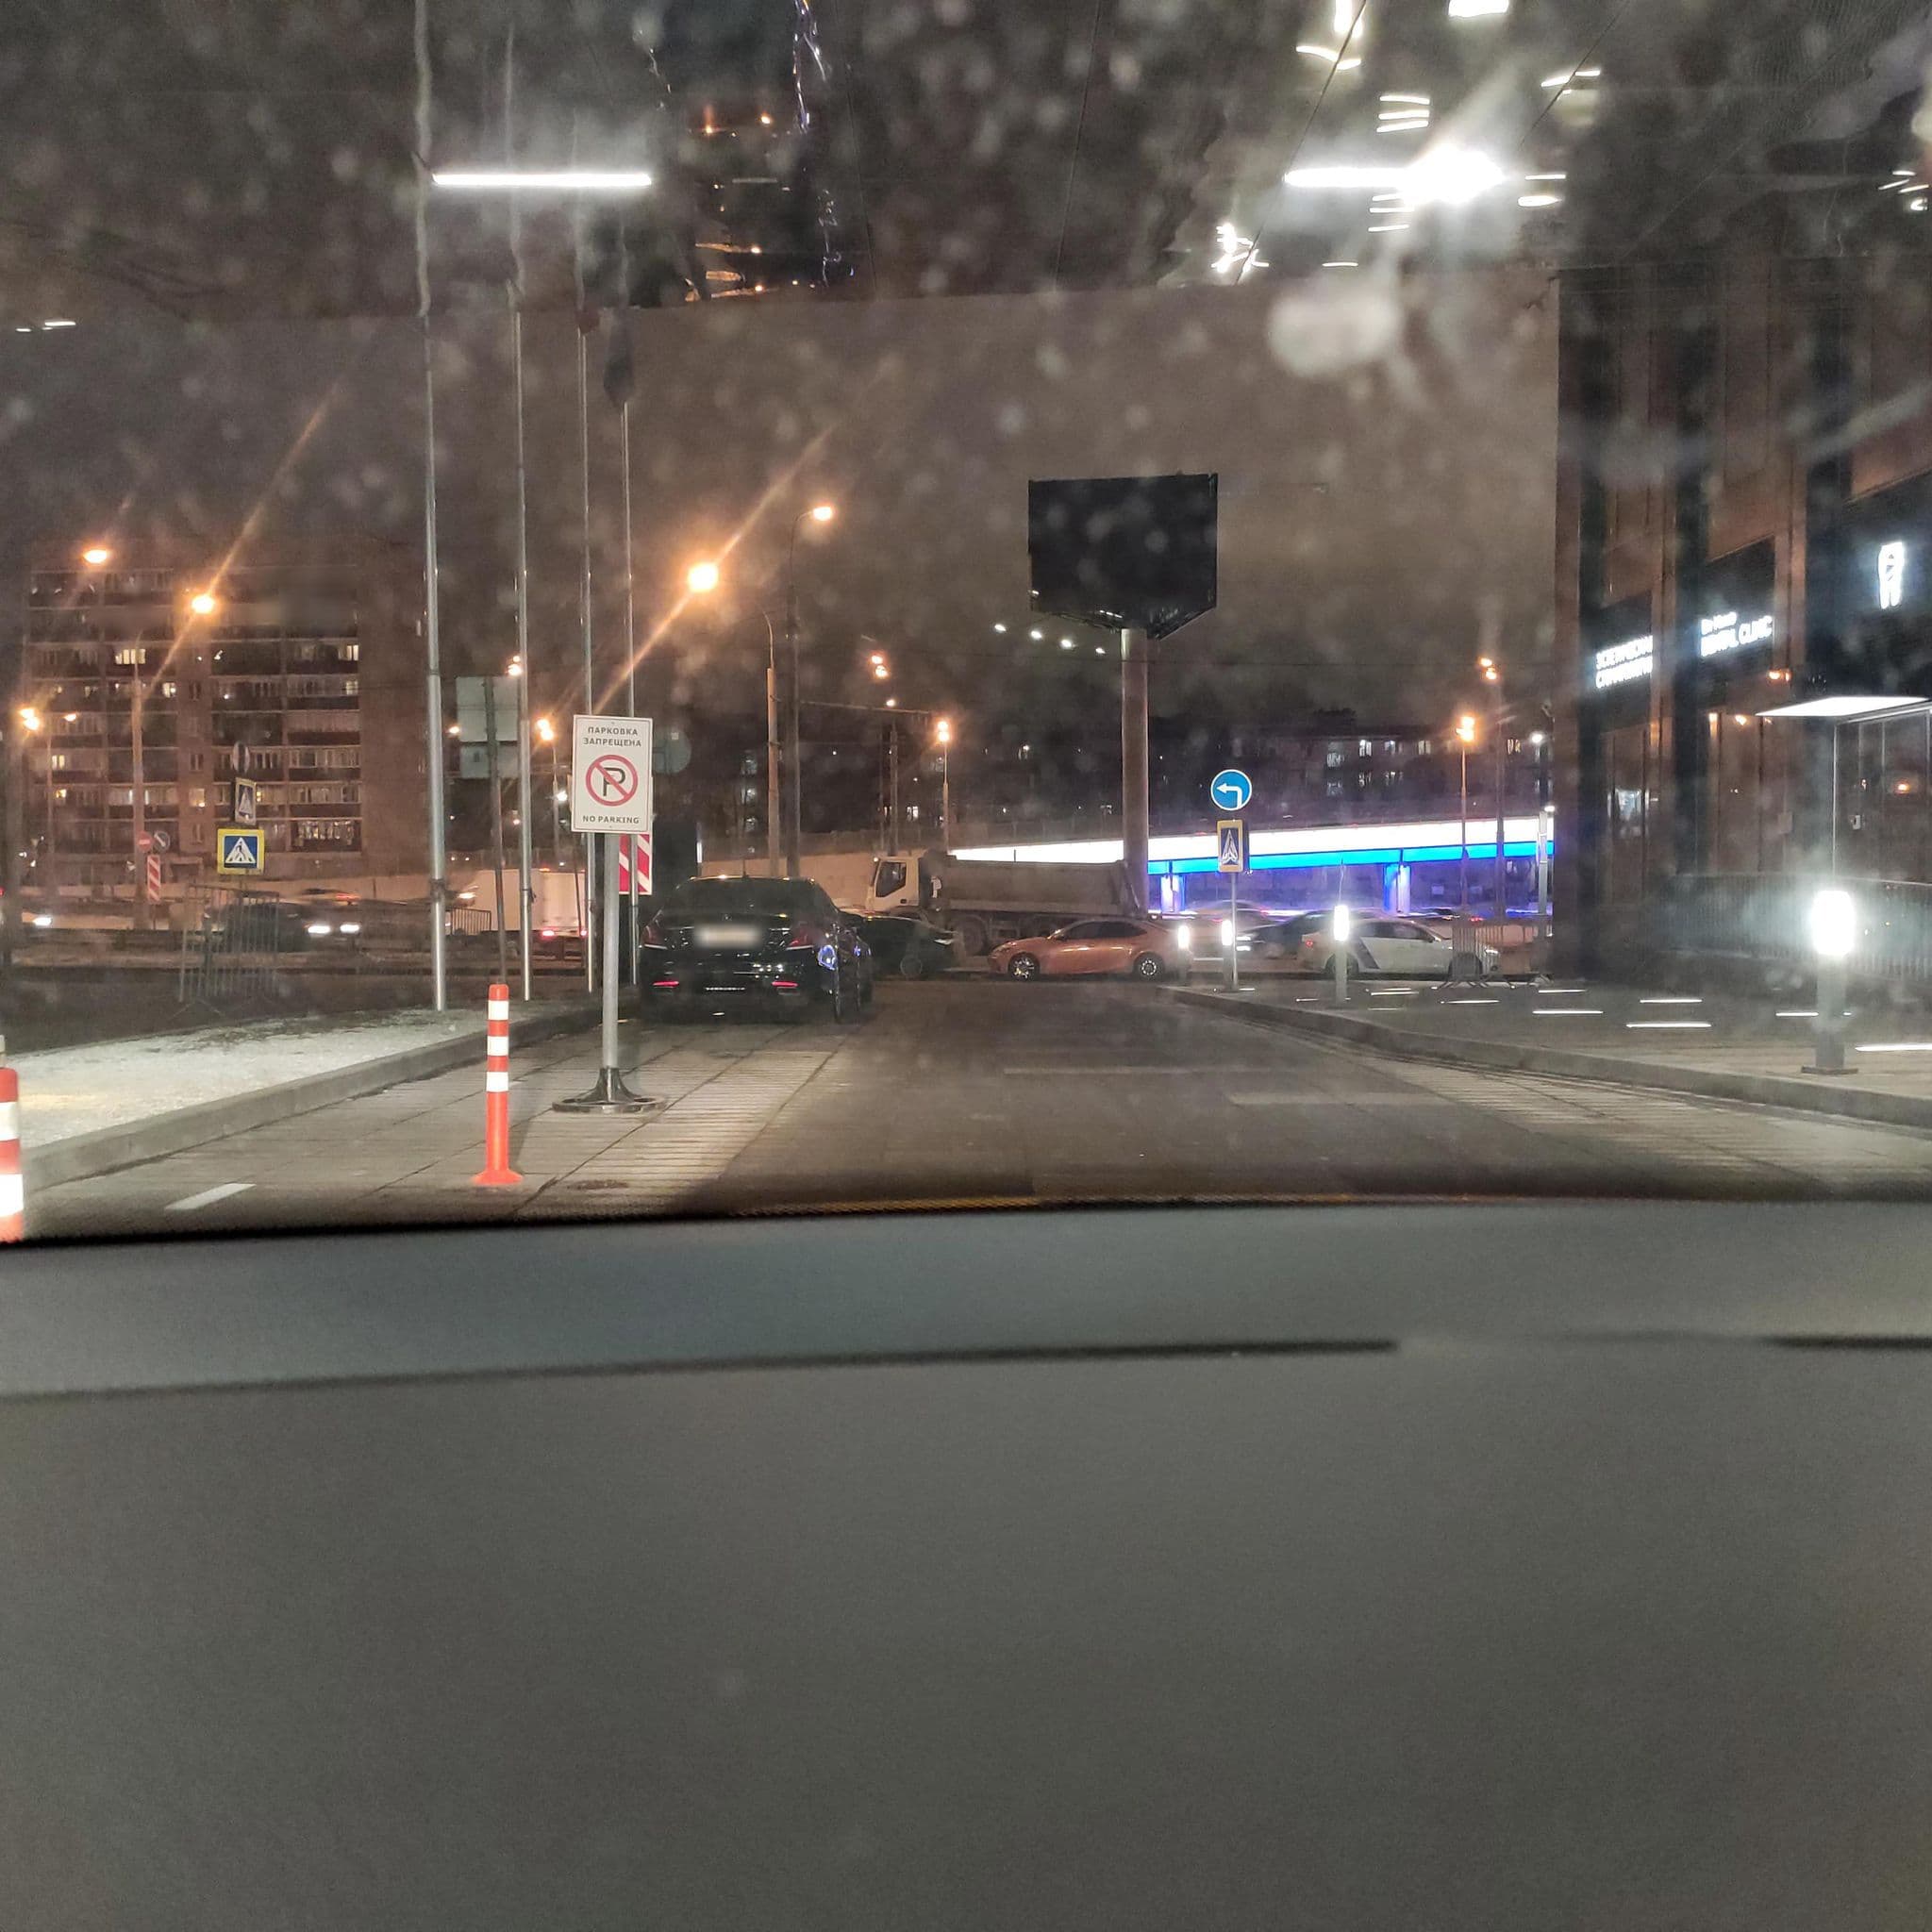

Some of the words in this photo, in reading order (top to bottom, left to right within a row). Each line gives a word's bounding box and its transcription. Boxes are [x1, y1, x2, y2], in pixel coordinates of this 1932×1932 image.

[588, 726, 638, 736] ПАРКОВКА
[583, 737, 641, 747] ЗАПРЕЩЕНА
[582, 815, 596, 824] NO
[598, 815, 640, 824] PARKING
